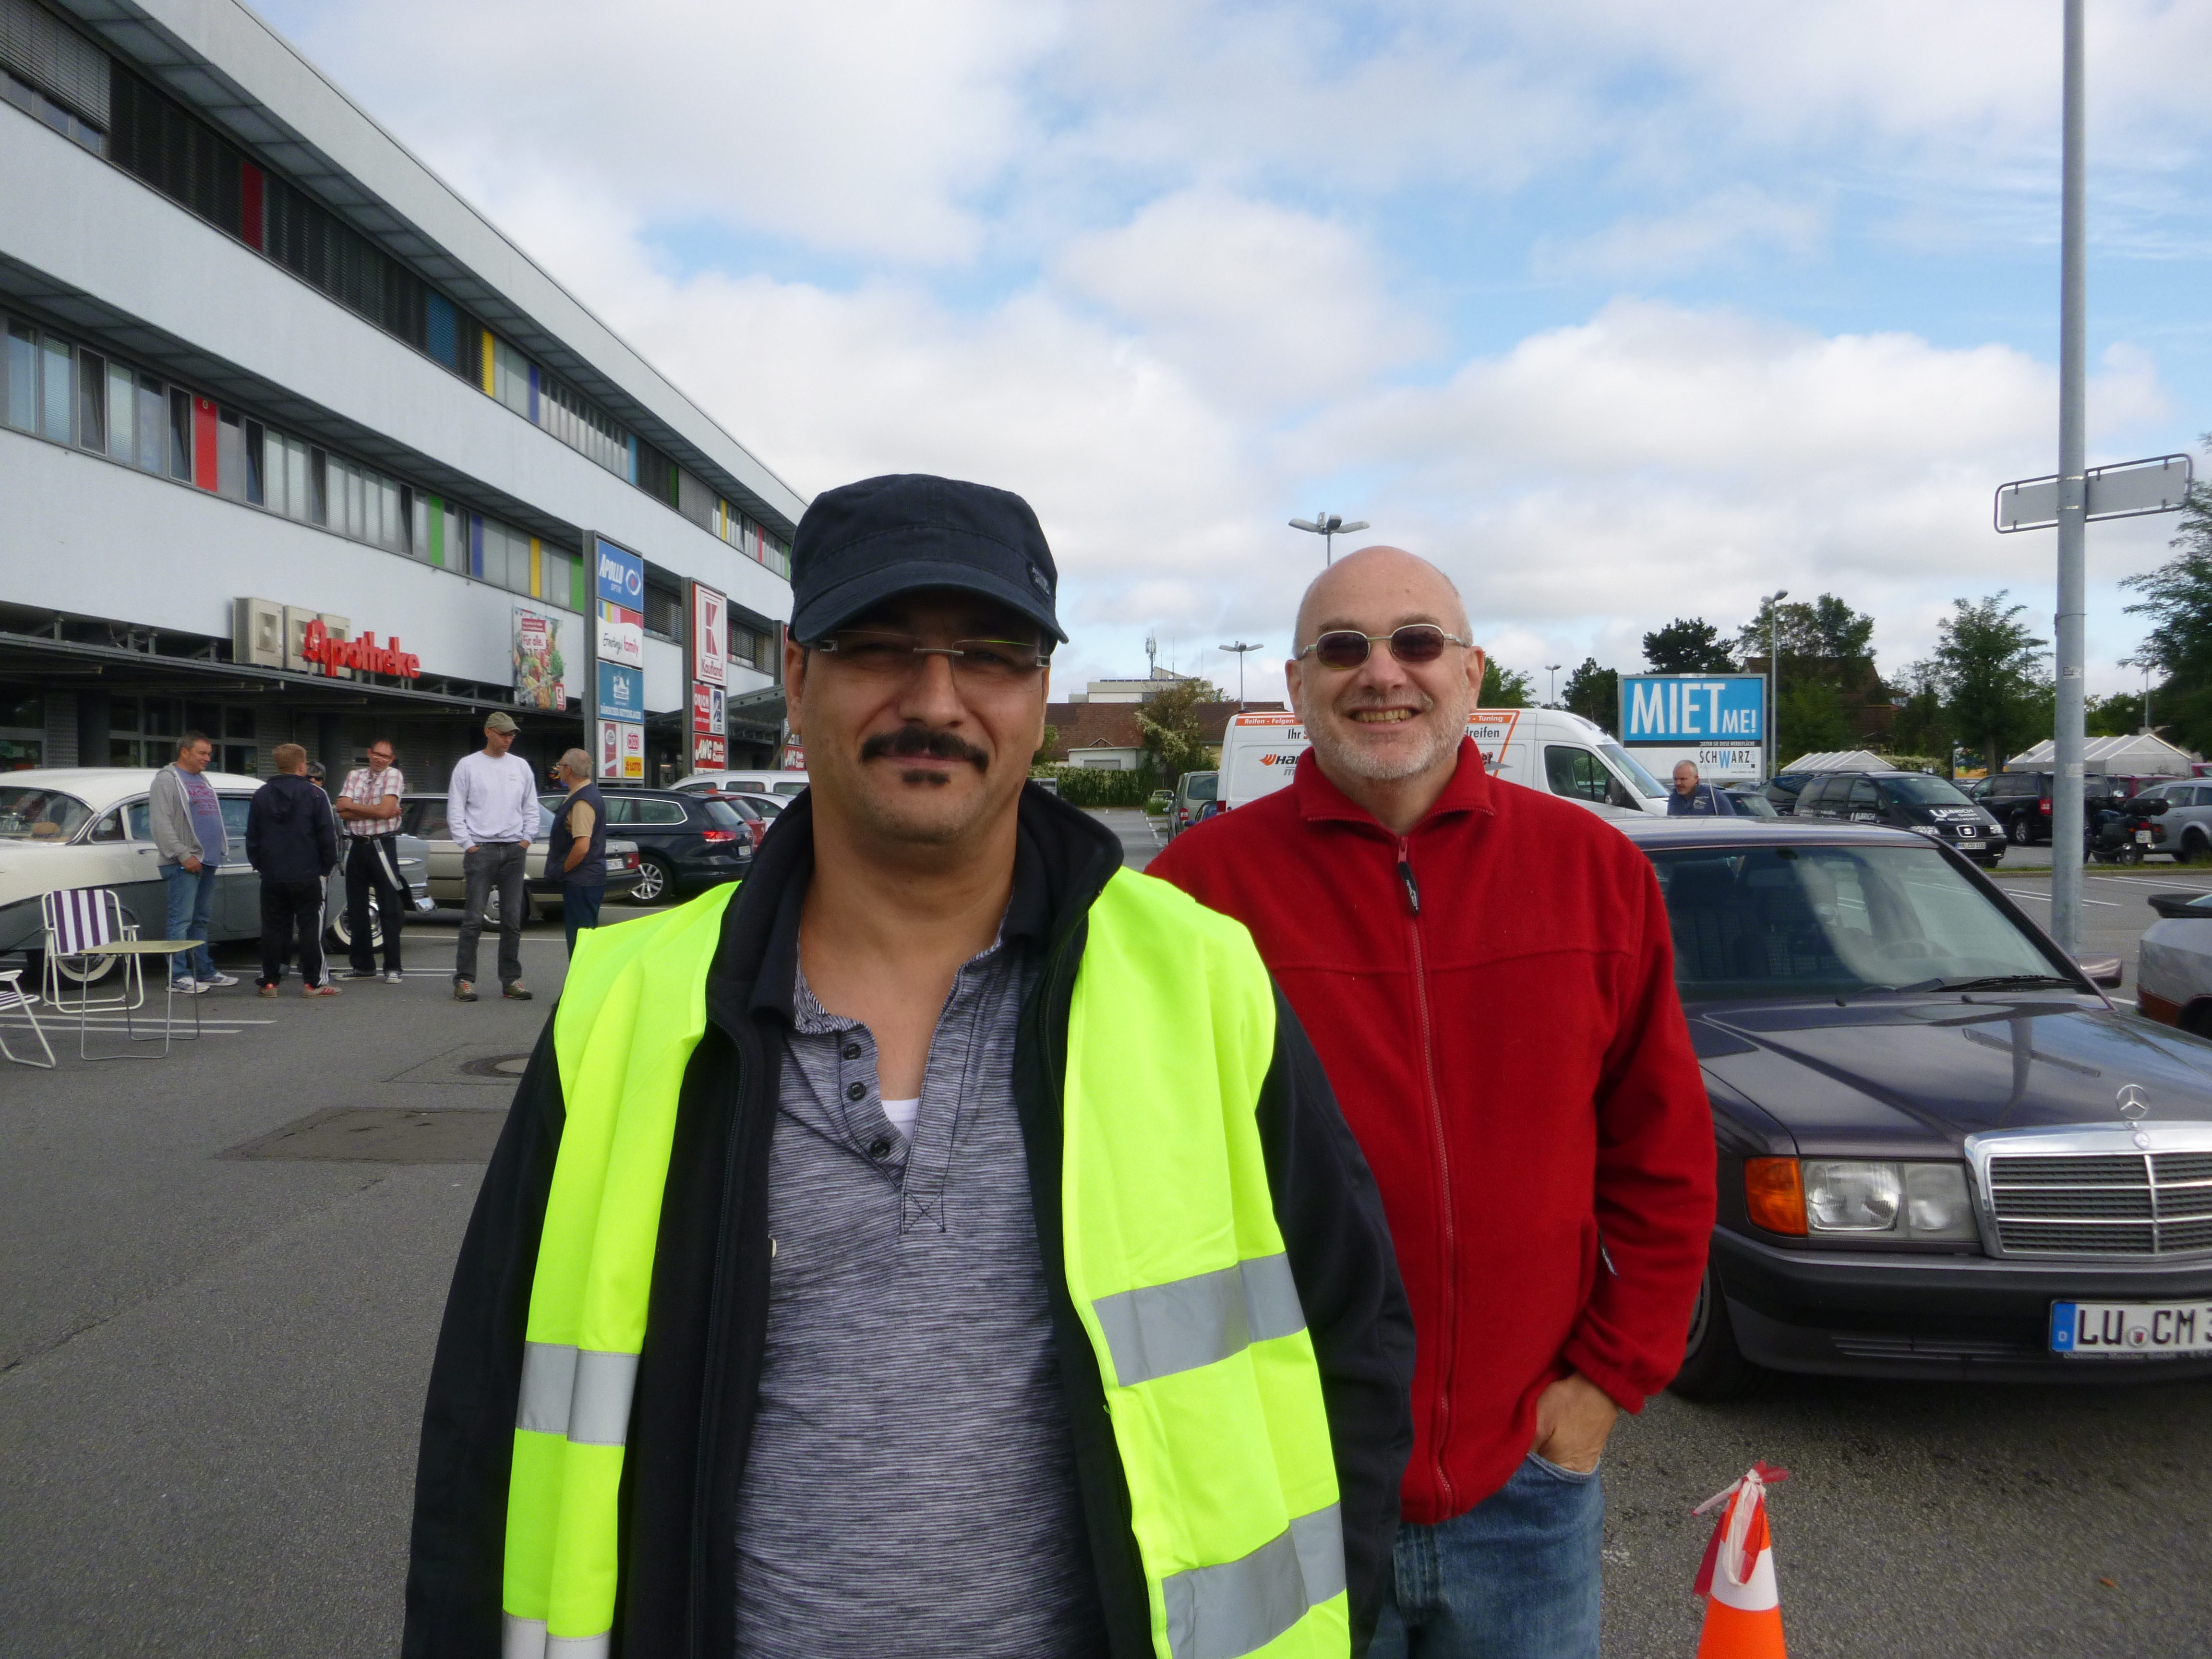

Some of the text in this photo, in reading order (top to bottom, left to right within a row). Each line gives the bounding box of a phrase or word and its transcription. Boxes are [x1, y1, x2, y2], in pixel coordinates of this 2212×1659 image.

[599, 553, 624, 584] APOLLO
[301, 619, 420, 679] Apotheke
[624, 636, 639, 658] family
[702, 659, 722, 677] Kaufland
[694, 693, 709, 712] ORION
[1630, 683, 1756, 734] MIET ME!
[1287, 728, 1301, 739] Ihr
[695, 739, 712, 761] AWG
[1699, 750, 1750, 769] SCHWARZ
[630, 762, 641, 771] LOTTO
[1929, 809, 1974, 817] ULBRICH
[2058, 1331, 2067, 1342] D
[2079, 1309, 2124, 1345] LU
[2151, 1309, 2196, 1344] CM
